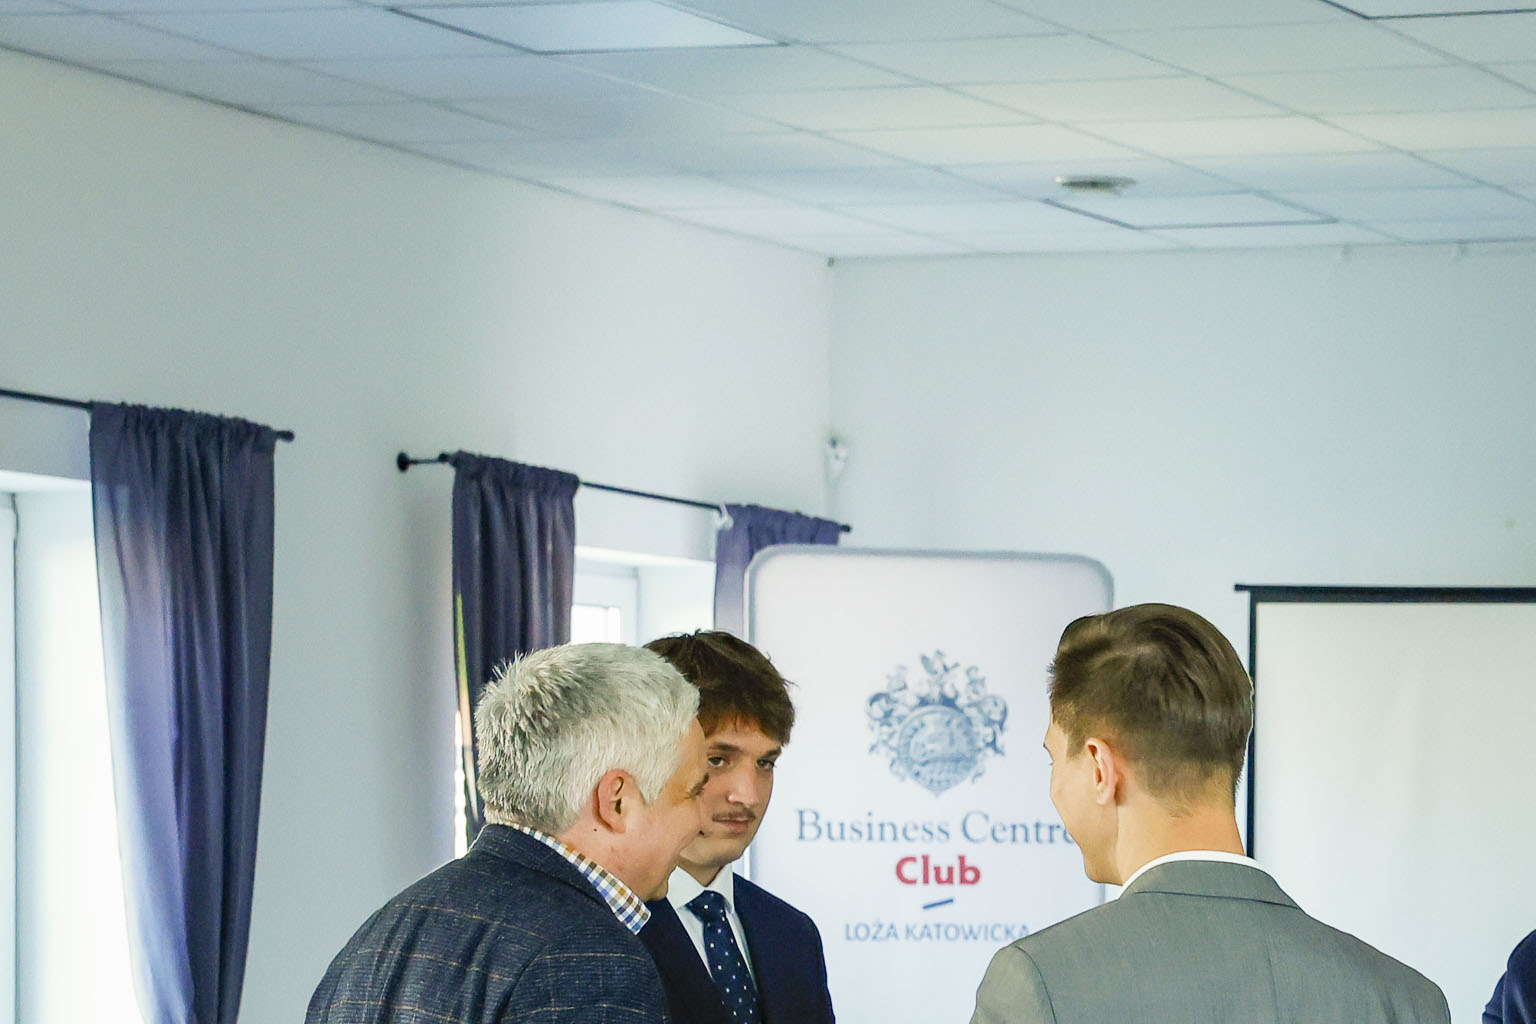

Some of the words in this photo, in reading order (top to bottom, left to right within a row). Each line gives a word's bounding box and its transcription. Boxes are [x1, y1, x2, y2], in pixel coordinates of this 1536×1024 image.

[795, 809, 950, 843] Business
[895, 855, 981, 885] Club
[844, 917, 899, 941] LOŻA
[905, 921, 1030, 942] KATOWICKA
